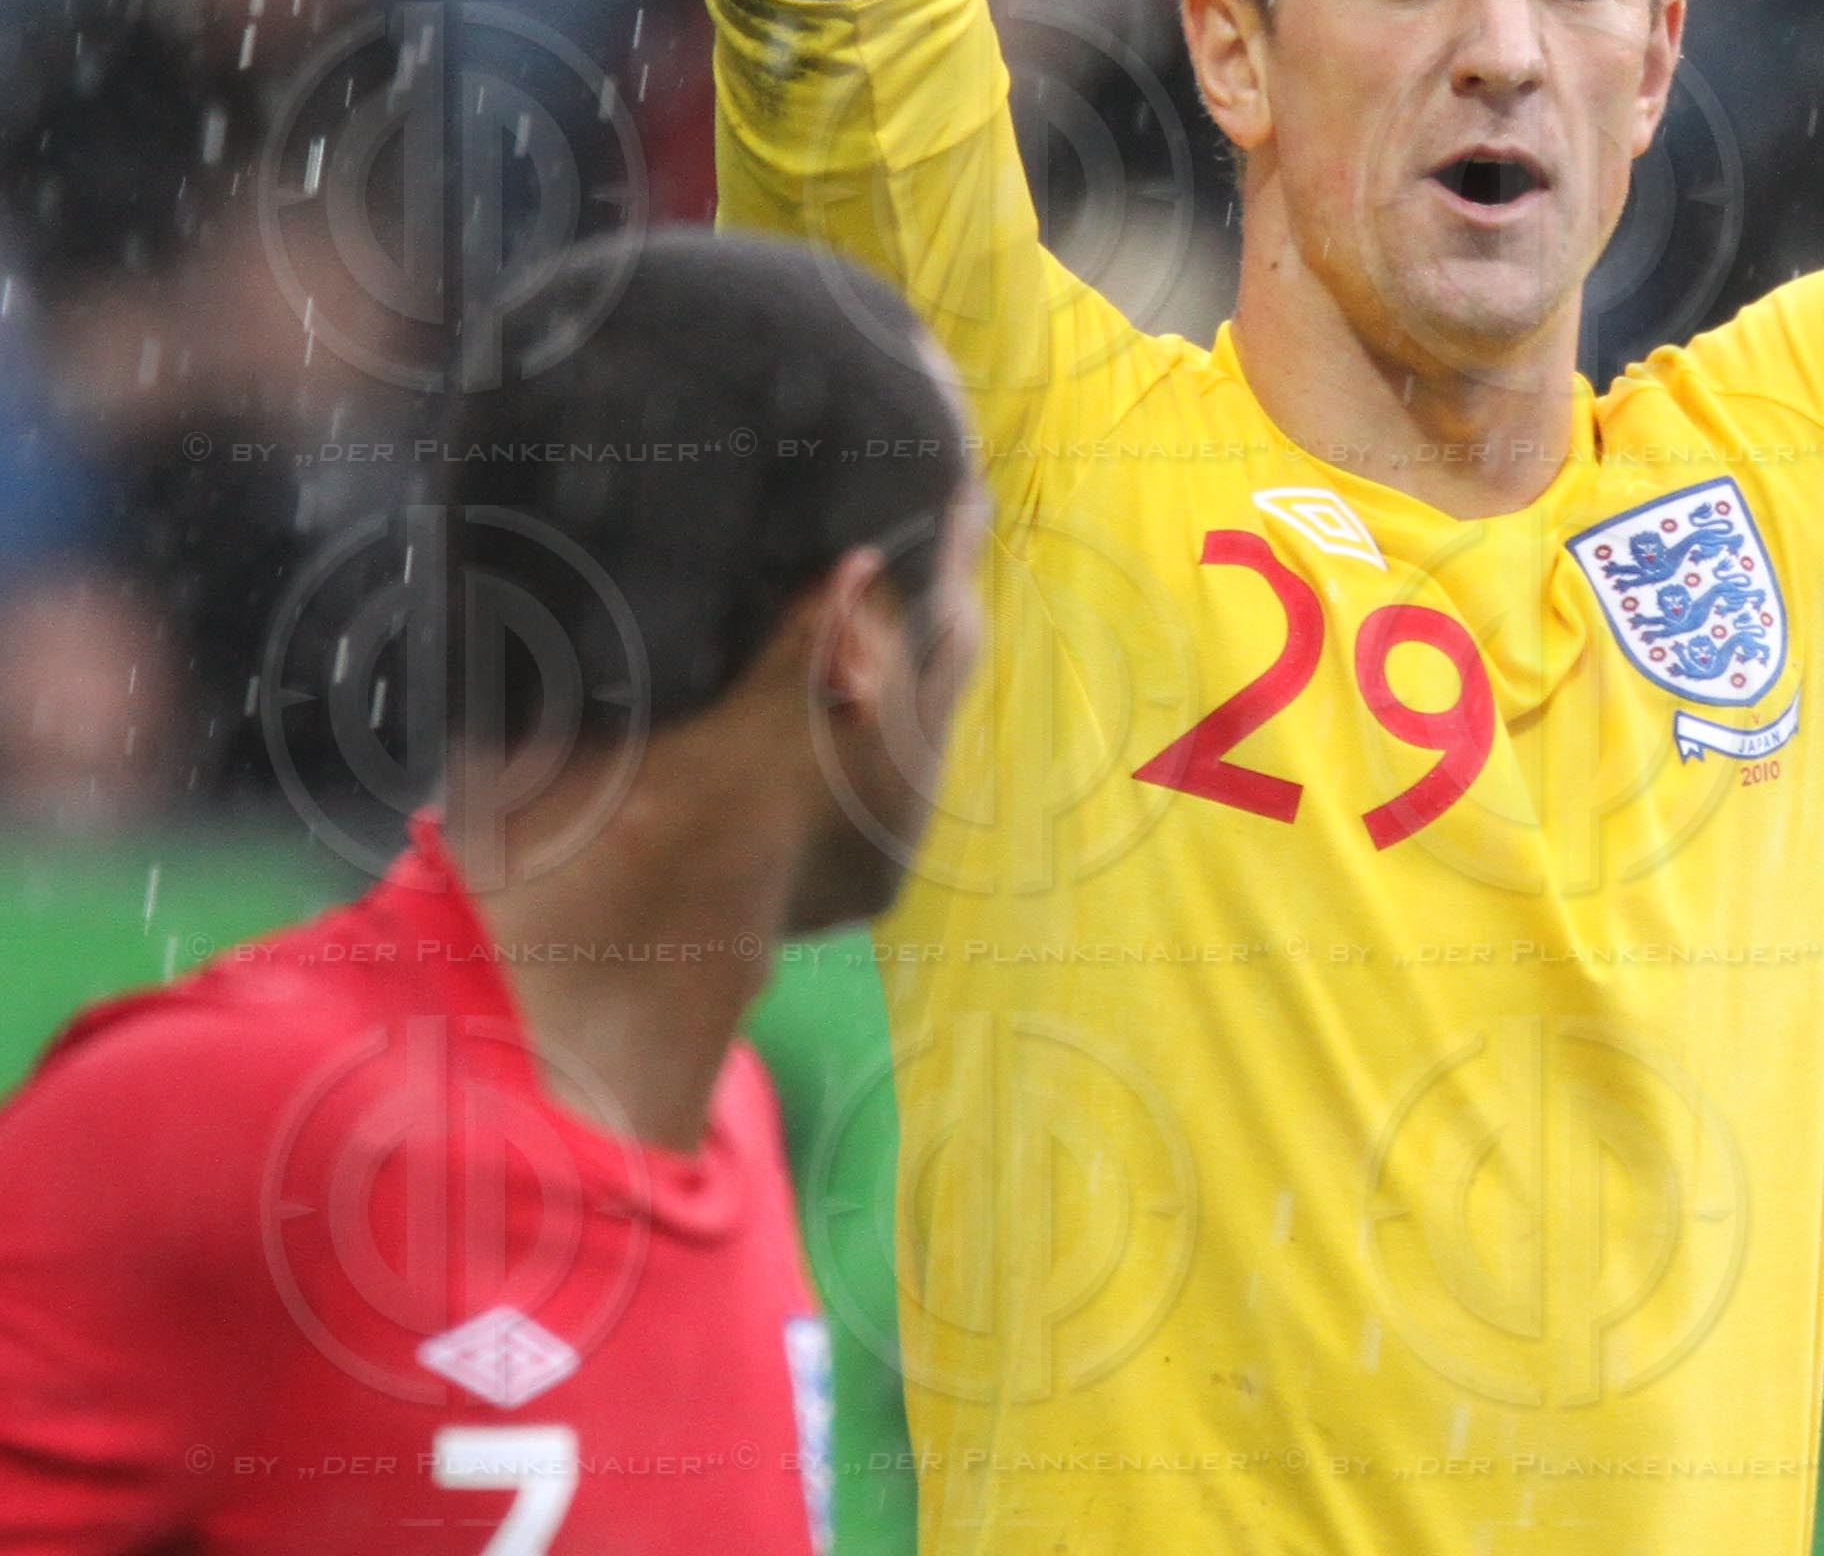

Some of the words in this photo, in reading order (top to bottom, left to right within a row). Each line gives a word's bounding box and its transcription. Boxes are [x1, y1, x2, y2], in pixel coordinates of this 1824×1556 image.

[1132, 529, 1496, 851] 29
[1739, 730, 1781, 753] JAPAN
[1741, 760, 1780, 786] 2010
[431, 1424, 581, 1556] 7
